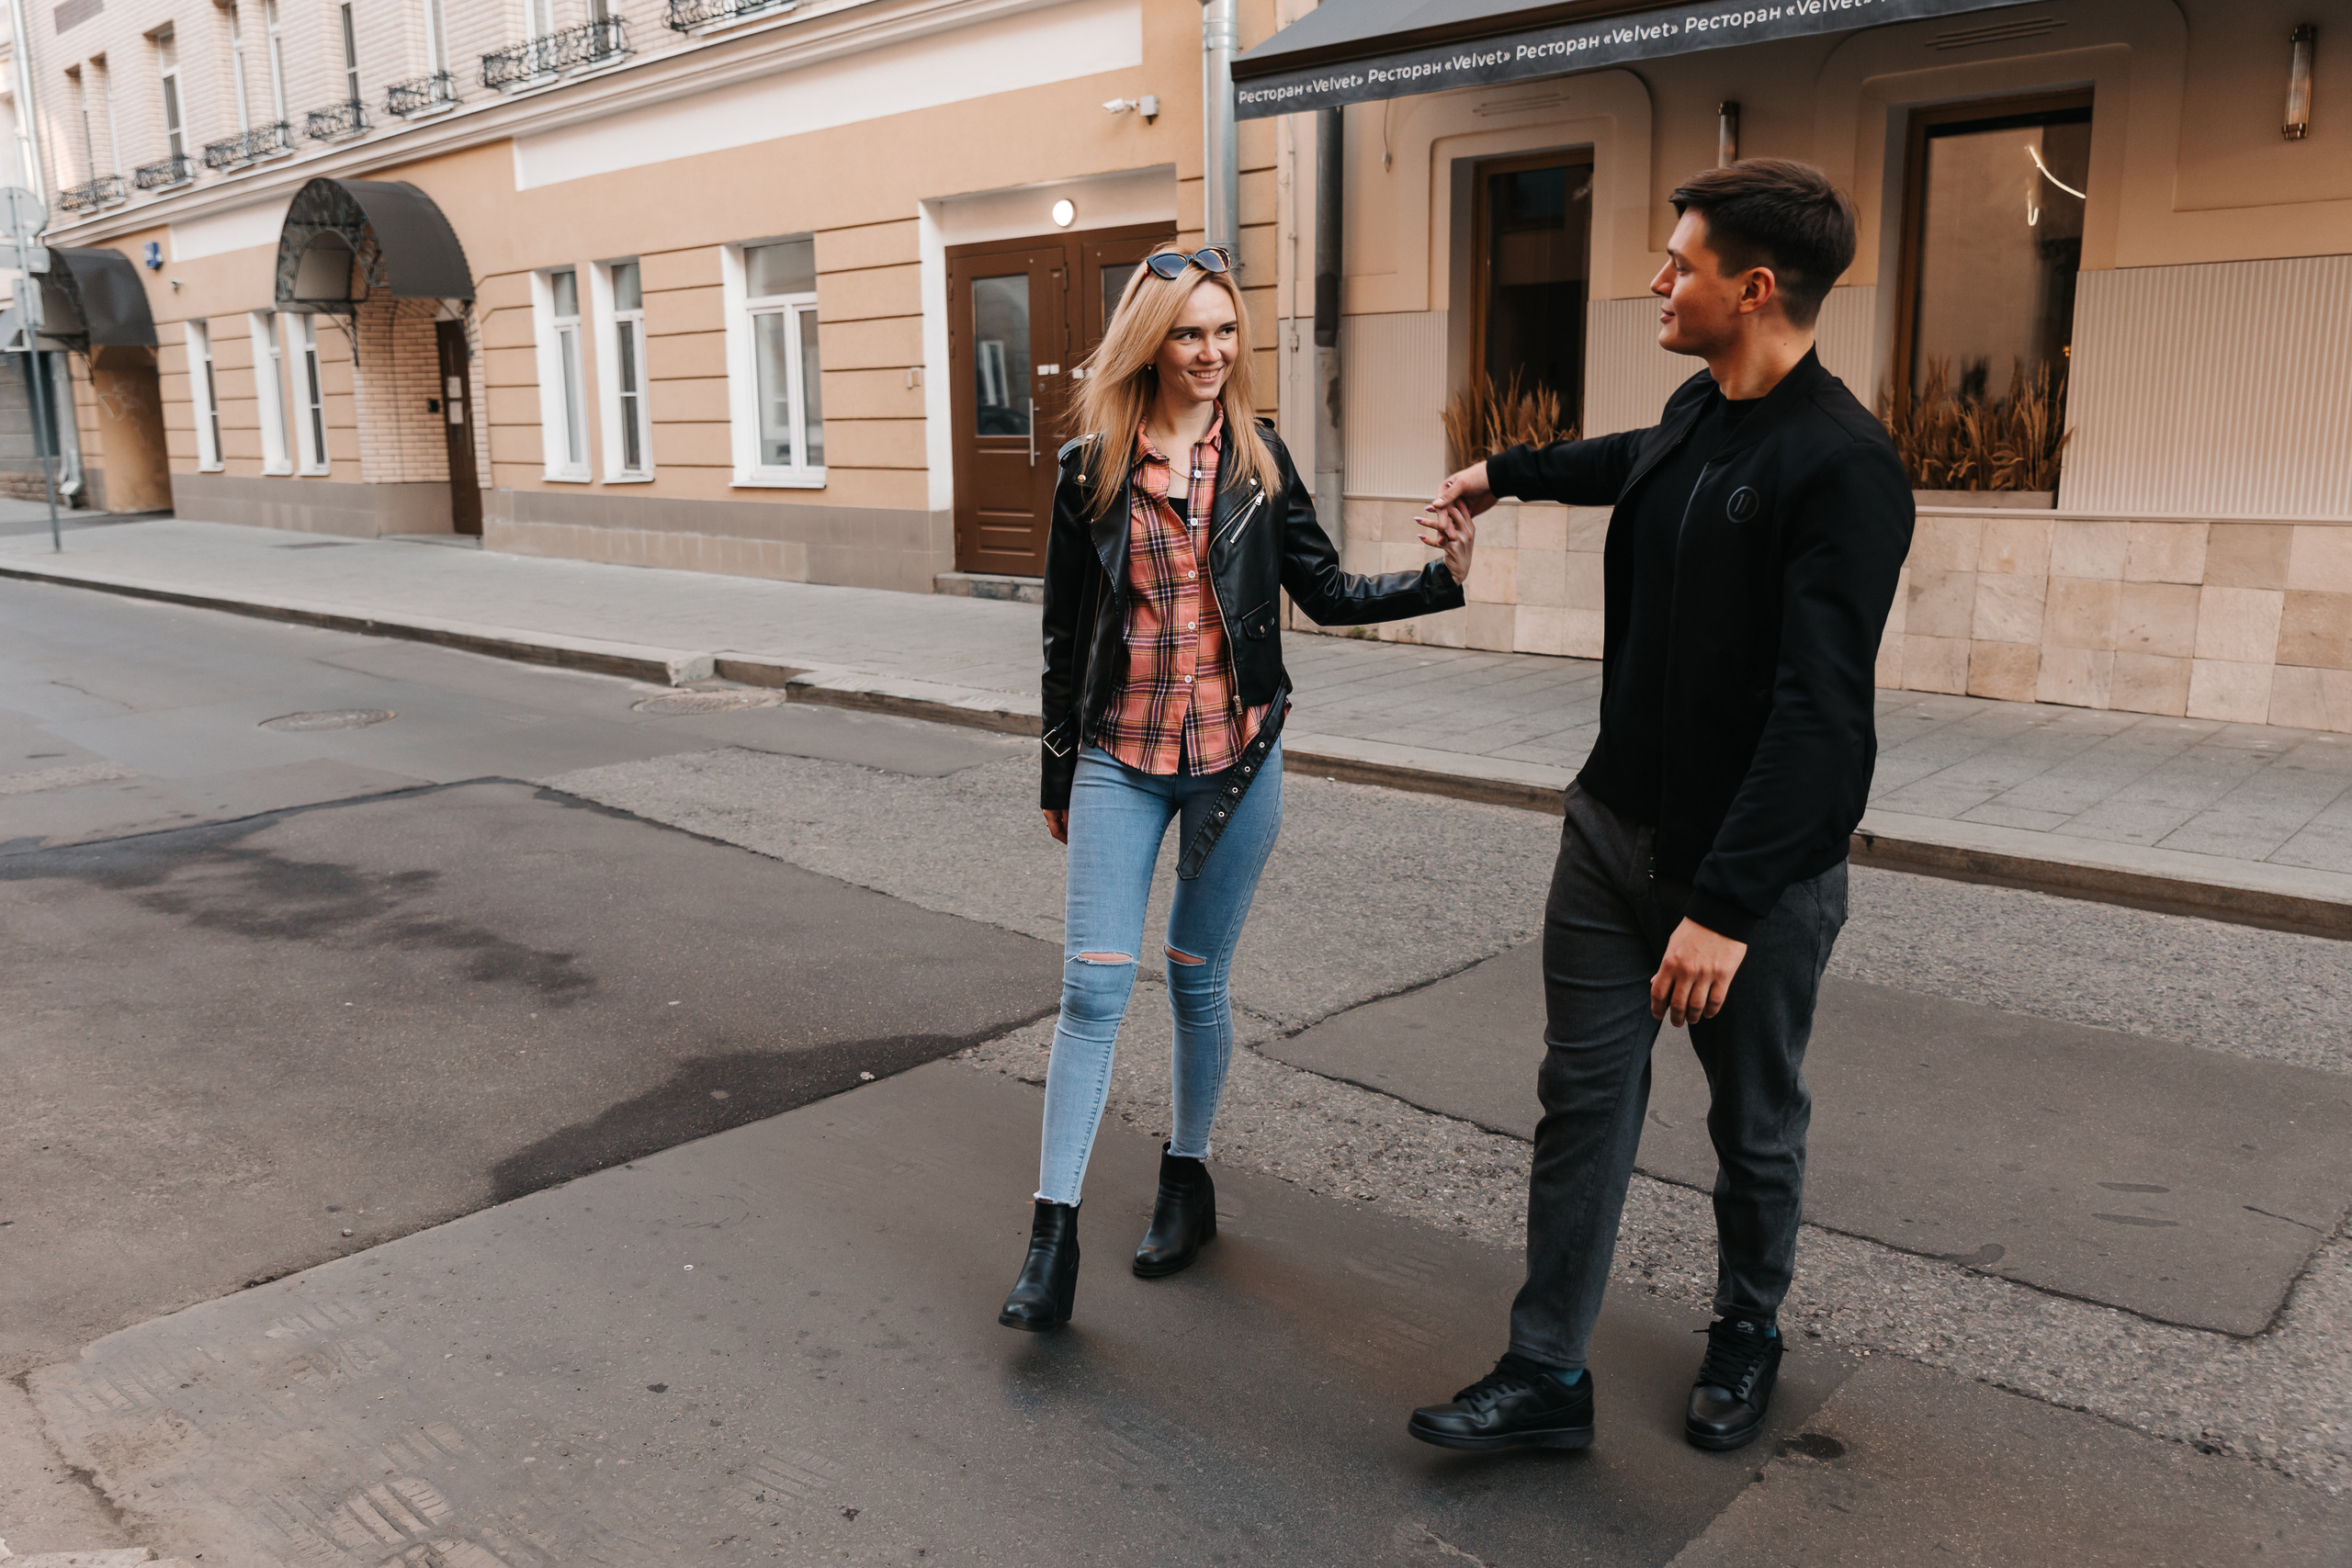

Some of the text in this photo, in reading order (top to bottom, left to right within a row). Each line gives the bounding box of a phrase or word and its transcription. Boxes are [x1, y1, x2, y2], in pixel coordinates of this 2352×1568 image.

[1238, 84, 1304, 105] Ресторан
[1306, 73, 1363, 94] «Velvet»
[1368, 61, 1442, 84] Ресторан
[1444, 49, 1511, 71] «Velvet»
[1516, 34, 1600, 61] Ресторан
[1603, 22, 1679, 45] «Velvet»
[1684, 6, 1781, 34] Ресторан
